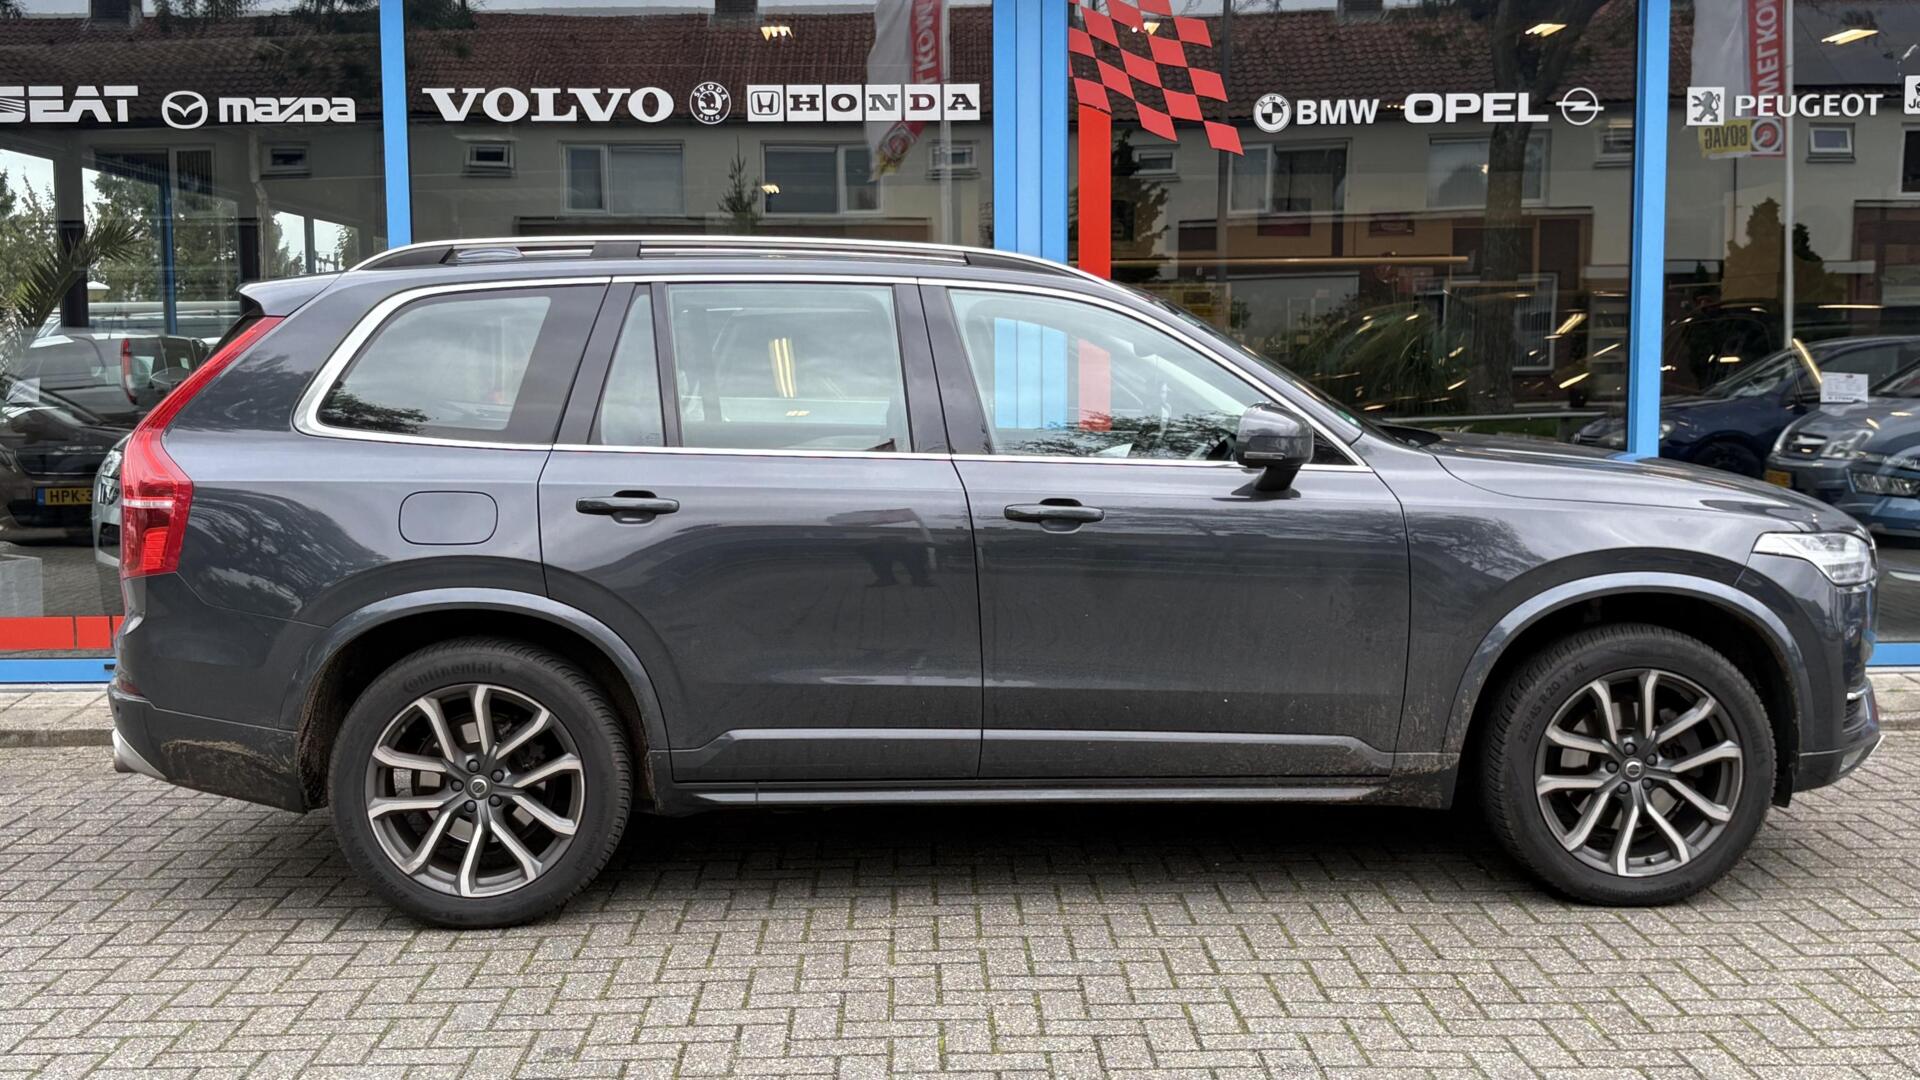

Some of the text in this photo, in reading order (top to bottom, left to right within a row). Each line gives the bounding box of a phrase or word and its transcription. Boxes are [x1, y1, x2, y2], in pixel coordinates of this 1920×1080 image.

[0, 85, 138, 123] SEAT
[219, 97, 356, 123] mazda
[421, 86, 675, 123] VOLVO
[790, 93, 977, 112] HONDA
[1296, 98, 1380, 125] BMW
[1404, 93, 1549, 123] OPEL
[1734, 93, 1884, 117] PEUGEOT
